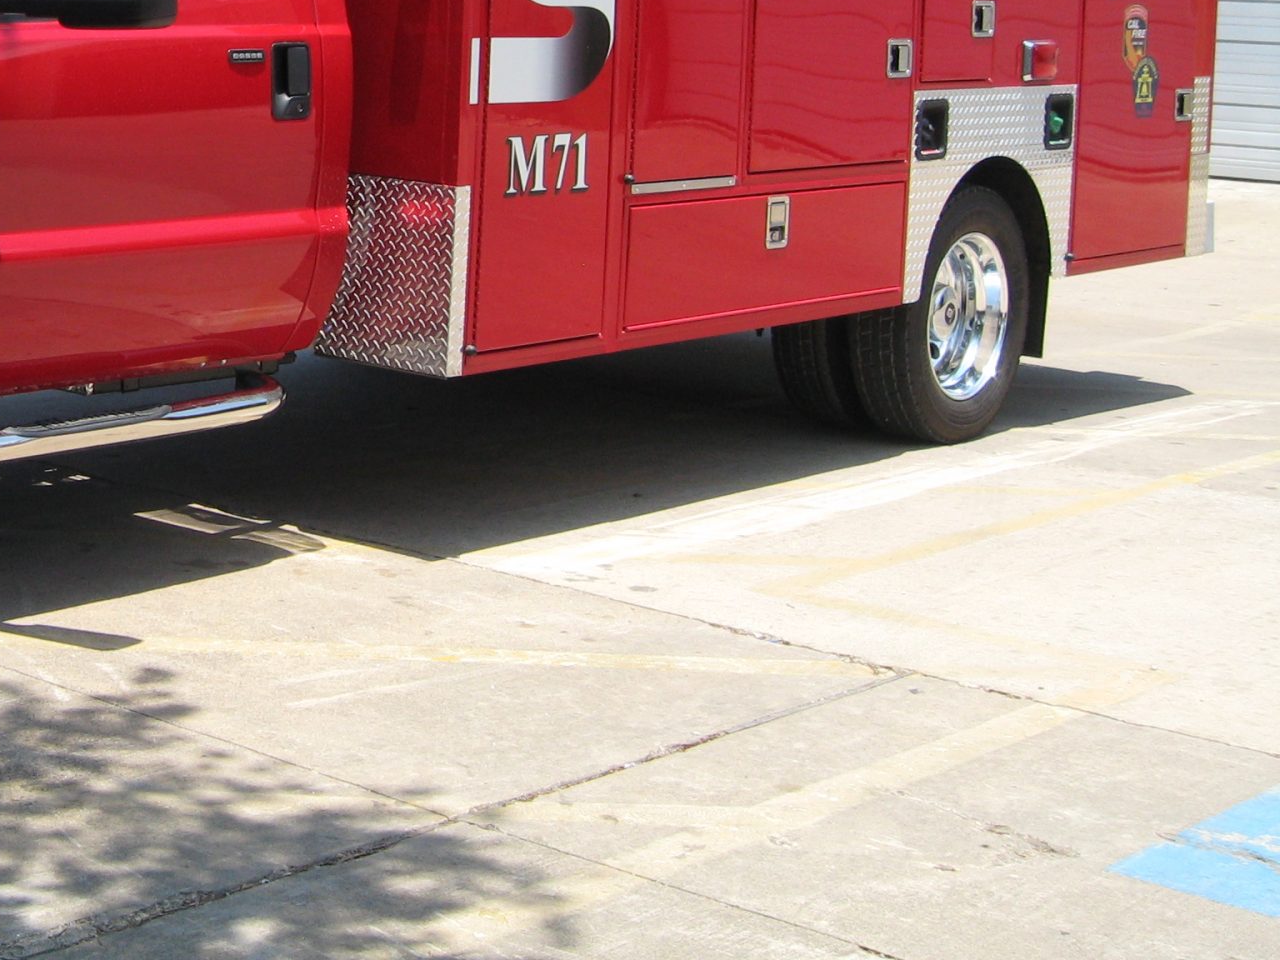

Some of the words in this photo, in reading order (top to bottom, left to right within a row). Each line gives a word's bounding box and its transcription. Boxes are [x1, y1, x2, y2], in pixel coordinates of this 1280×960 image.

[1127, 19, 1140, 29] CAL
[1131, 28, 1147, 39] FIRE
[505, 132, 589, 195] M71
